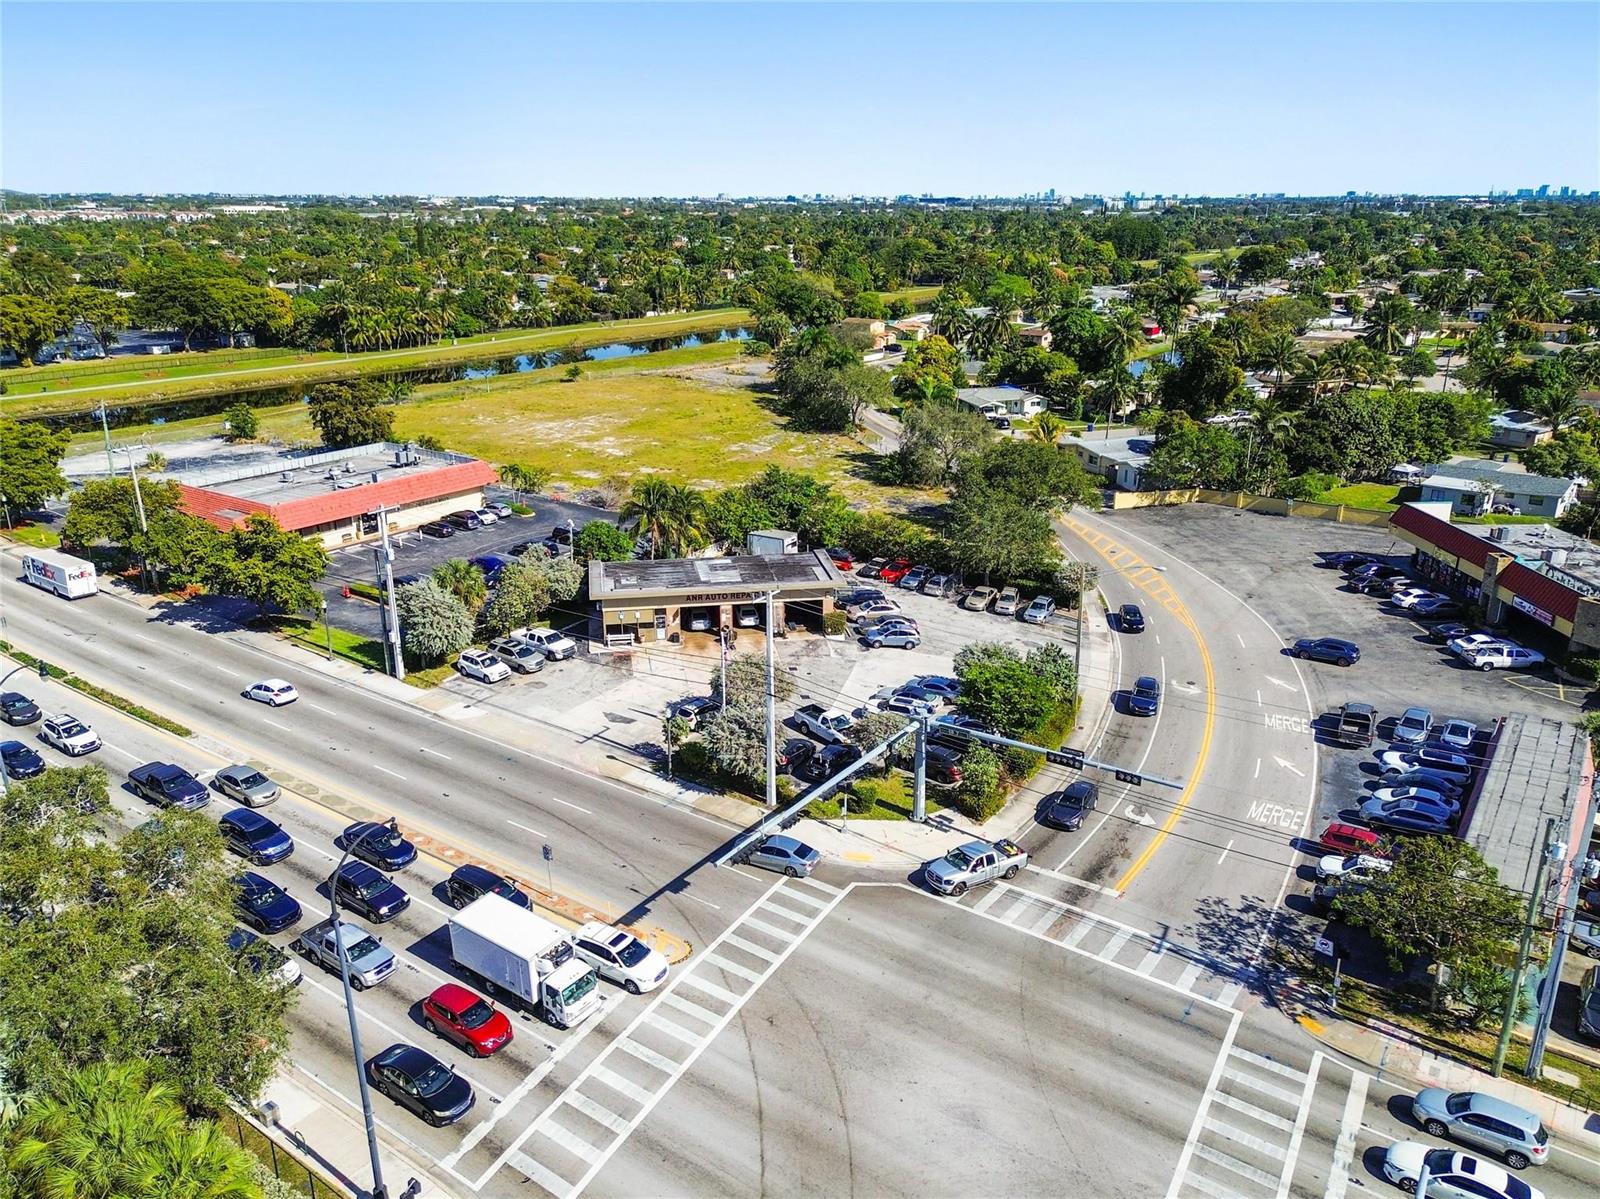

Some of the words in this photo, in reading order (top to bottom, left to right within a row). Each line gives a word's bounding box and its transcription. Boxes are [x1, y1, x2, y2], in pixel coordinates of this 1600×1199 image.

[31, 558, 56, 580] FedEx
[68, 570, 92, 581] FedEx
[705, 593, 728, 601] AUTO
[730, 591, 761, 600] REPAR
[1264, 713, 1309, 733] MERGE
[1247, 800, 1303, 830] MERGE
